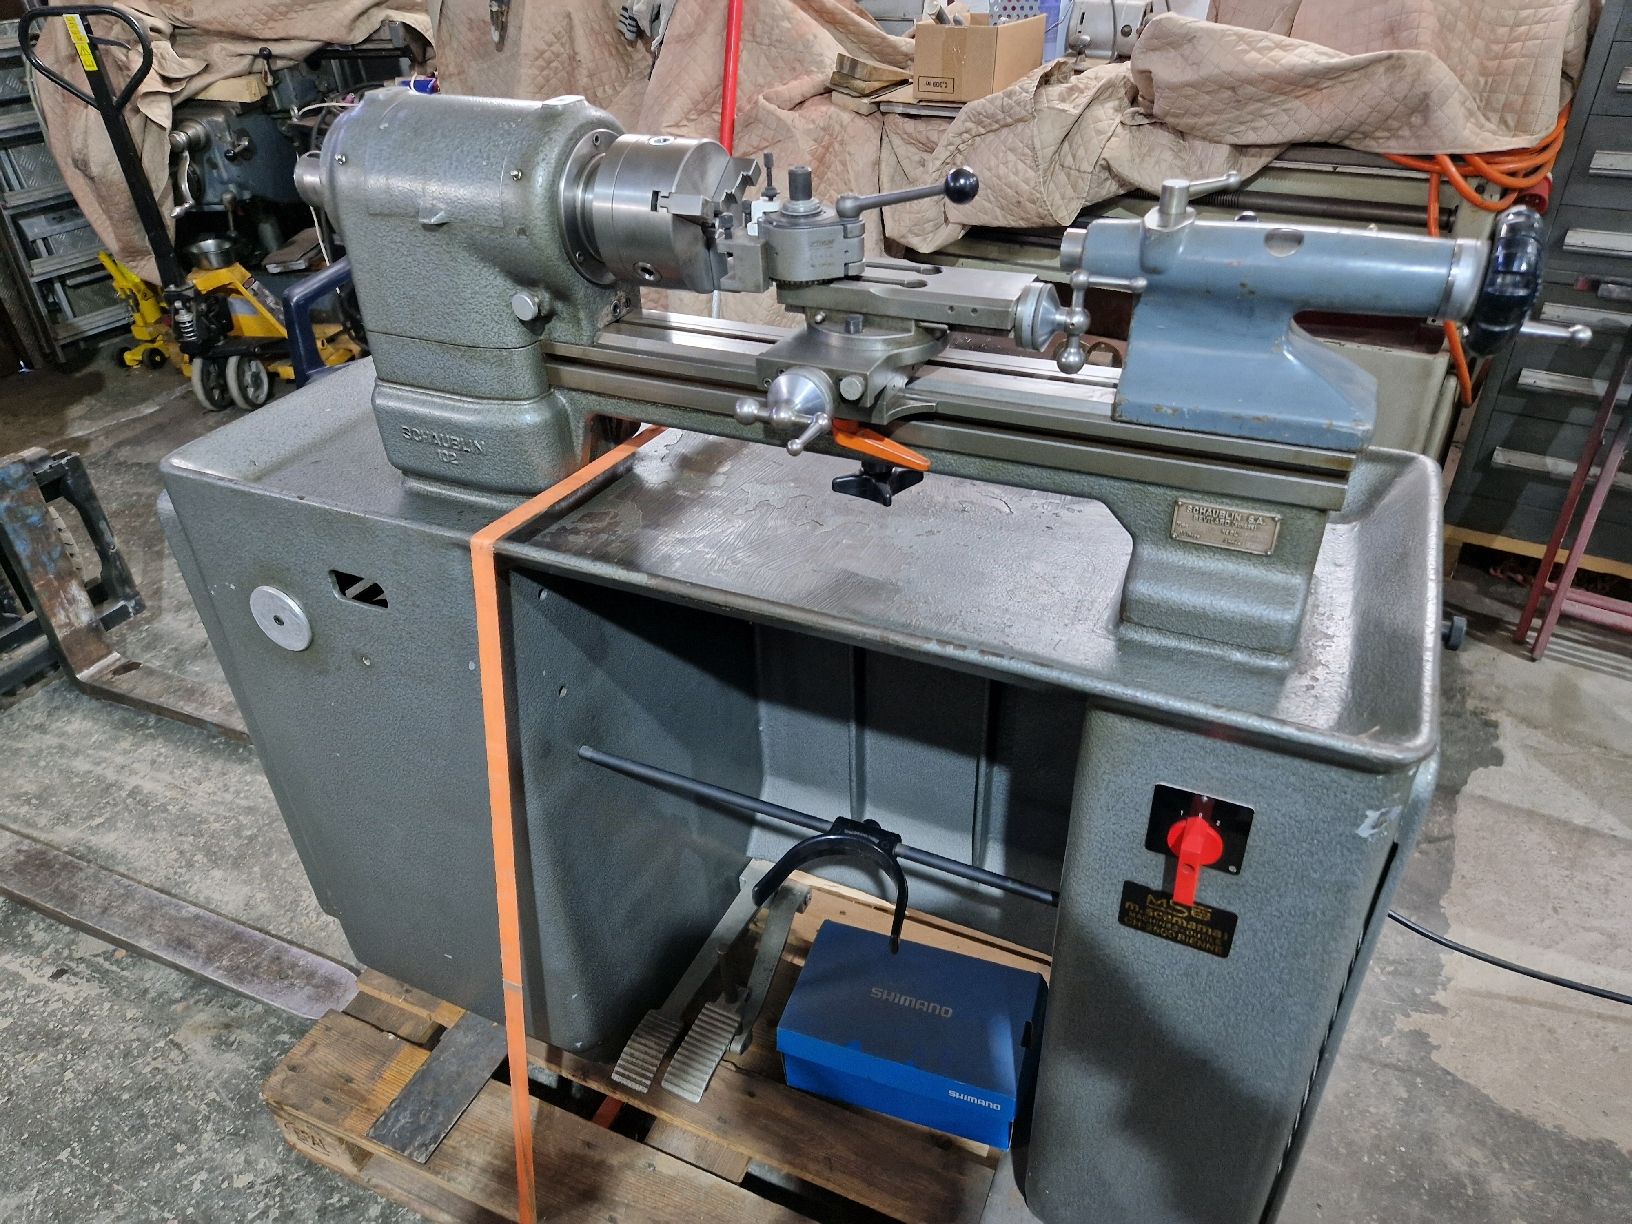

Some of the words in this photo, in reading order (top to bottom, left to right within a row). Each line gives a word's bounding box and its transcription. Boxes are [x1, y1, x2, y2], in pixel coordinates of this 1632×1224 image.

[401, 425, 485, 453] SCHAUBLIN
[438, 449, 459, 465] 102
[1186, 504, 1242, 521] SCHAUBLIN
[870, 988, 953, 1018] SHIMANO
[949, 1090, 1001, 1111] SHIMANO
